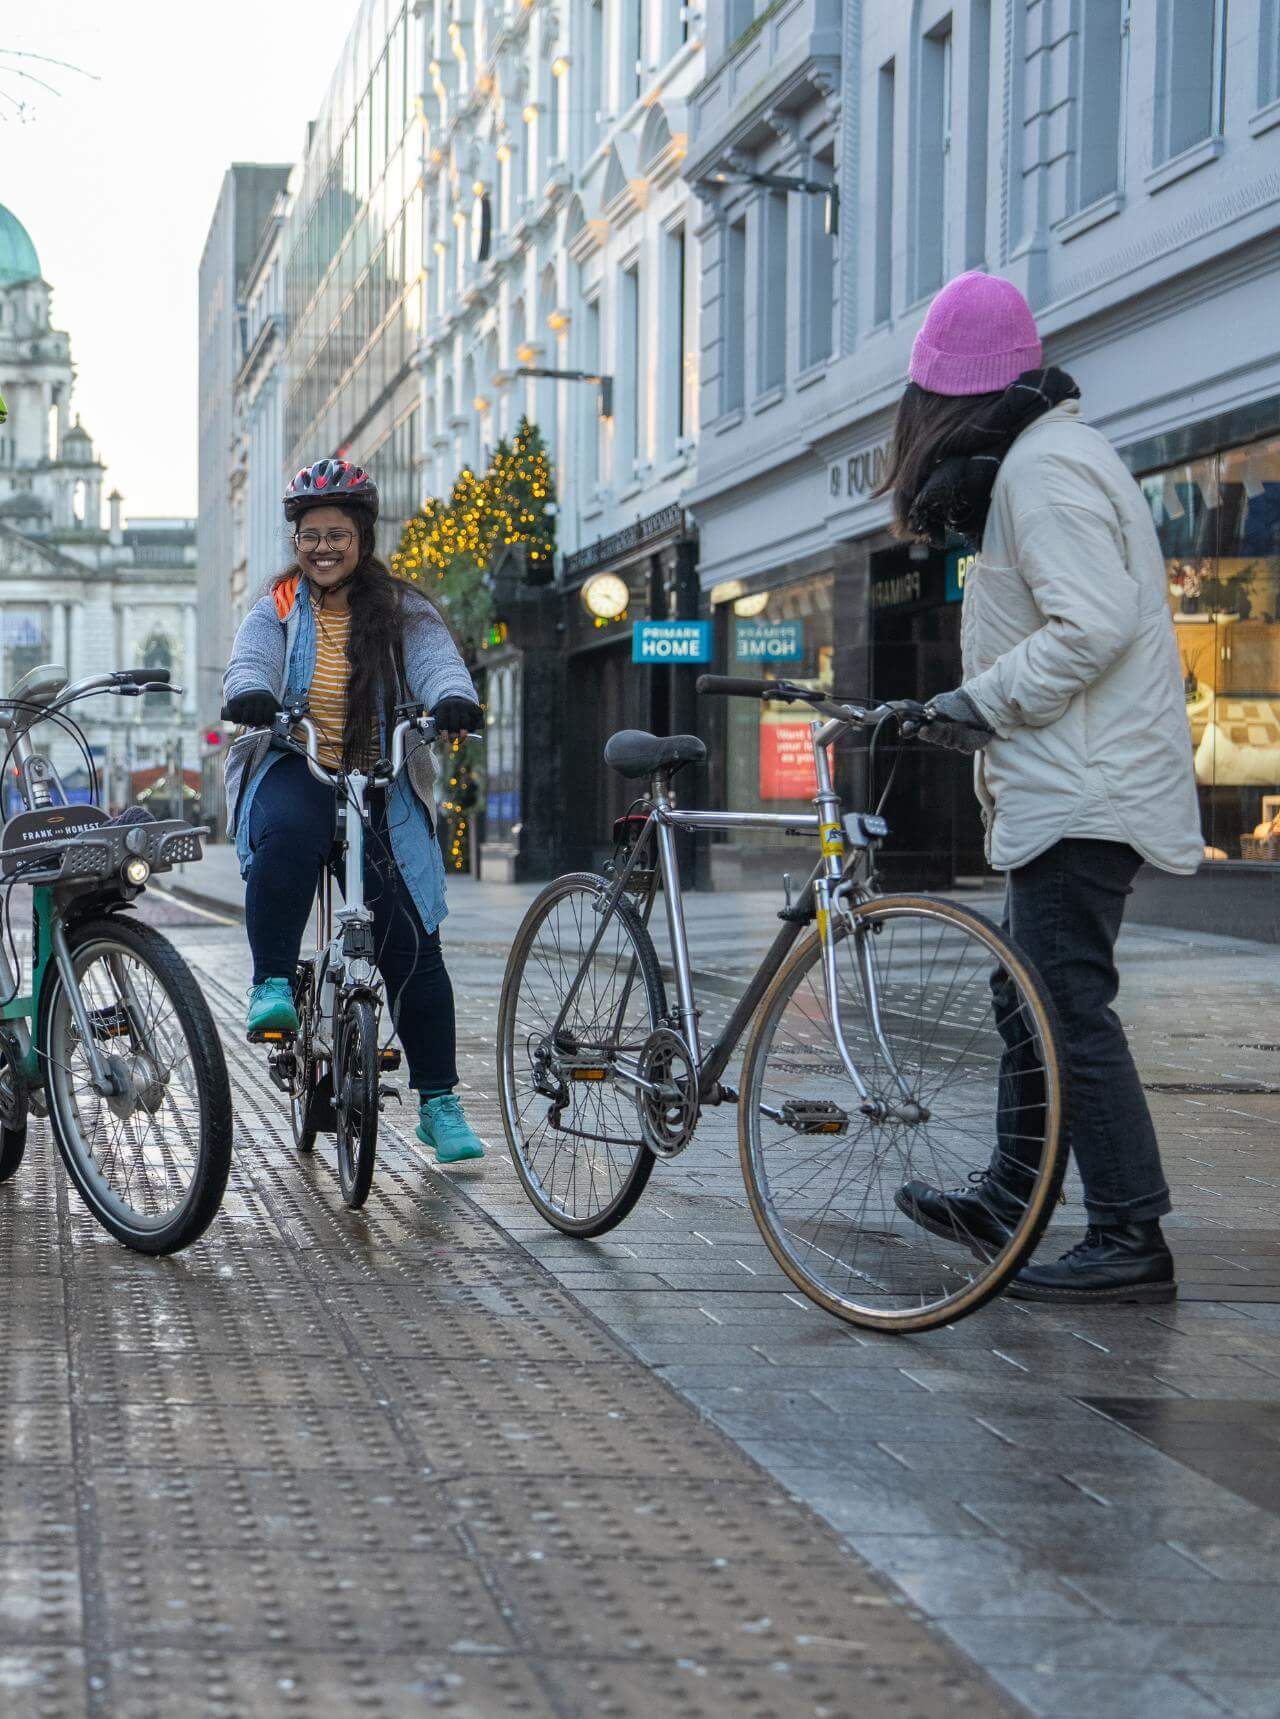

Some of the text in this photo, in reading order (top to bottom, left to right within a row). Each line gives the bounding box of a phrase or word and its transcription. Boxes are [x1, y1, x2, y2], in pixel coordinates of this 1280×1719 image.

[847, 440, 894, 497] FOUN
[642, 627, 700, 639] PRIMARK
[642, 639, 700, 657] HOME
[22, 829, 53, 841] FRANK
[65, 822, 99, 834] HONEST
